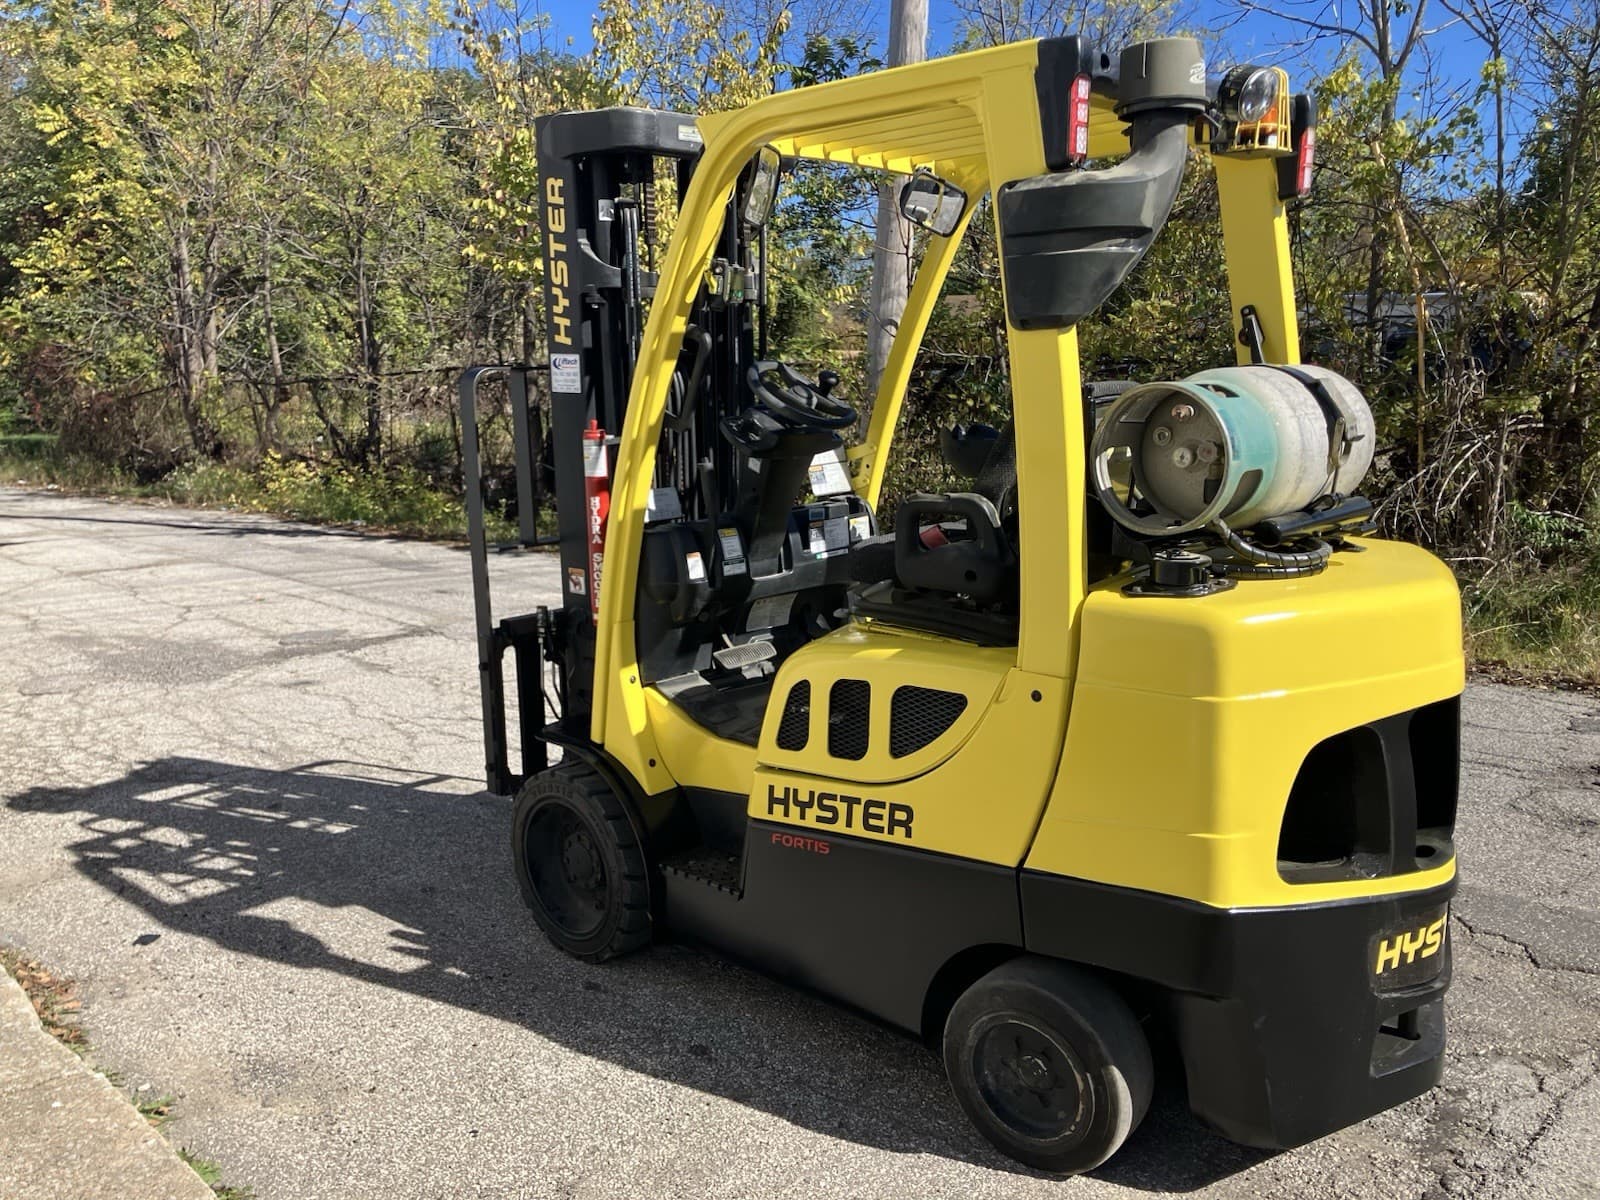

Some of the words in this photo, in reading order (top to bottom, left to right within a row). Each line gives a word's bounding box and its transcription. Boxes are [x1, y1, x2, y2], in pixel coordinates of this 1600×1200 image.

[546, 177, 572, 345] HYSTER
[590, 496, 602, 544] HYDRA
[767, 784, 914, 838] HYSTER
[771, 833, 830, 855] FORTIS
